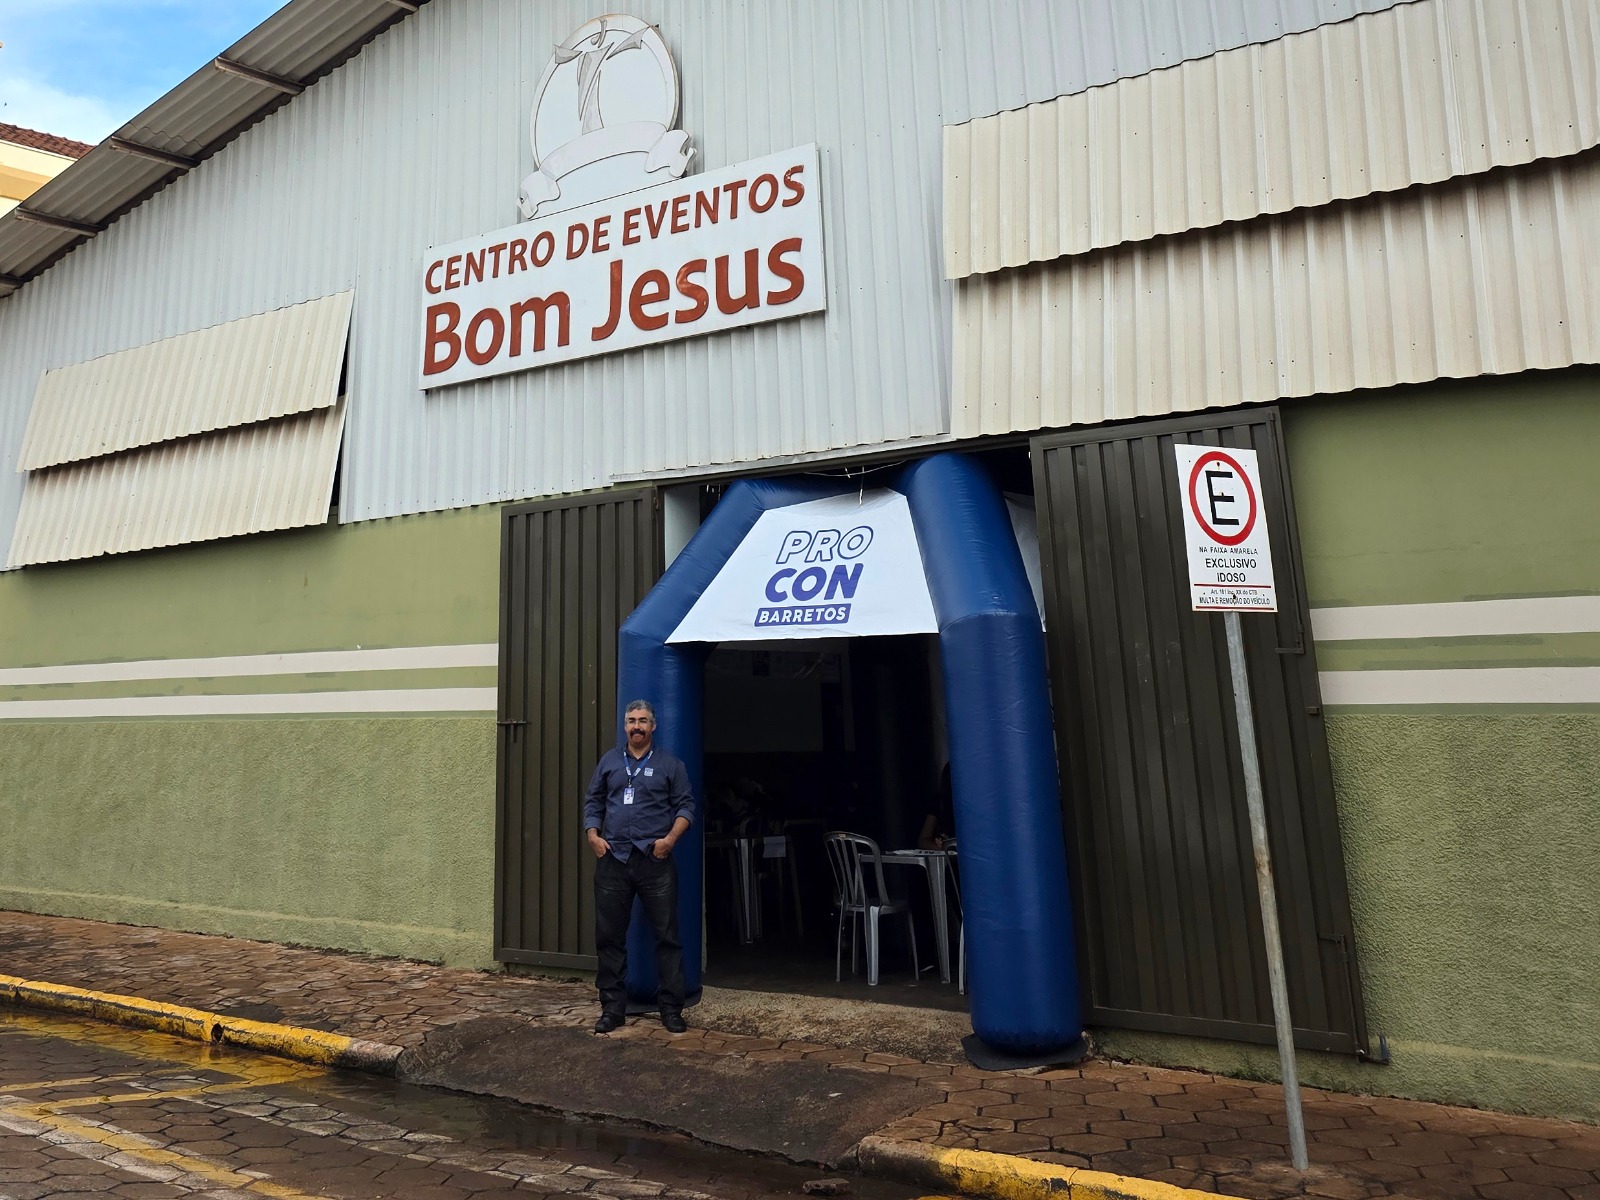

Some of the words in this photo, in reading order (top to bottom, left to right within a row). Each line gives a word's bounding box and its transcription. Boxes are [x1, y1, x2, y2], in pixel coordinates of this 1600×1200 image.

[425, 230, 555, 294] CENTRO
[566, 215, 611, 261] DE
[622, 164, 805, 246] EVENTOS
[423, 291, 570, 376] Bom
[591, 237, 804, 342] Jesus
[1205, 470, 1239, 525] E
[775, 525, 874, 564] PRO
[1205, 558, 1257, 569] EXCLUSIVO
[1230, 547, 1258, 555] AMARELA
[765, 563, 864, 603] CON
[1217, 572, 1246, 582] IDOSO
[758, 606, 847, 623] BARRETOS
